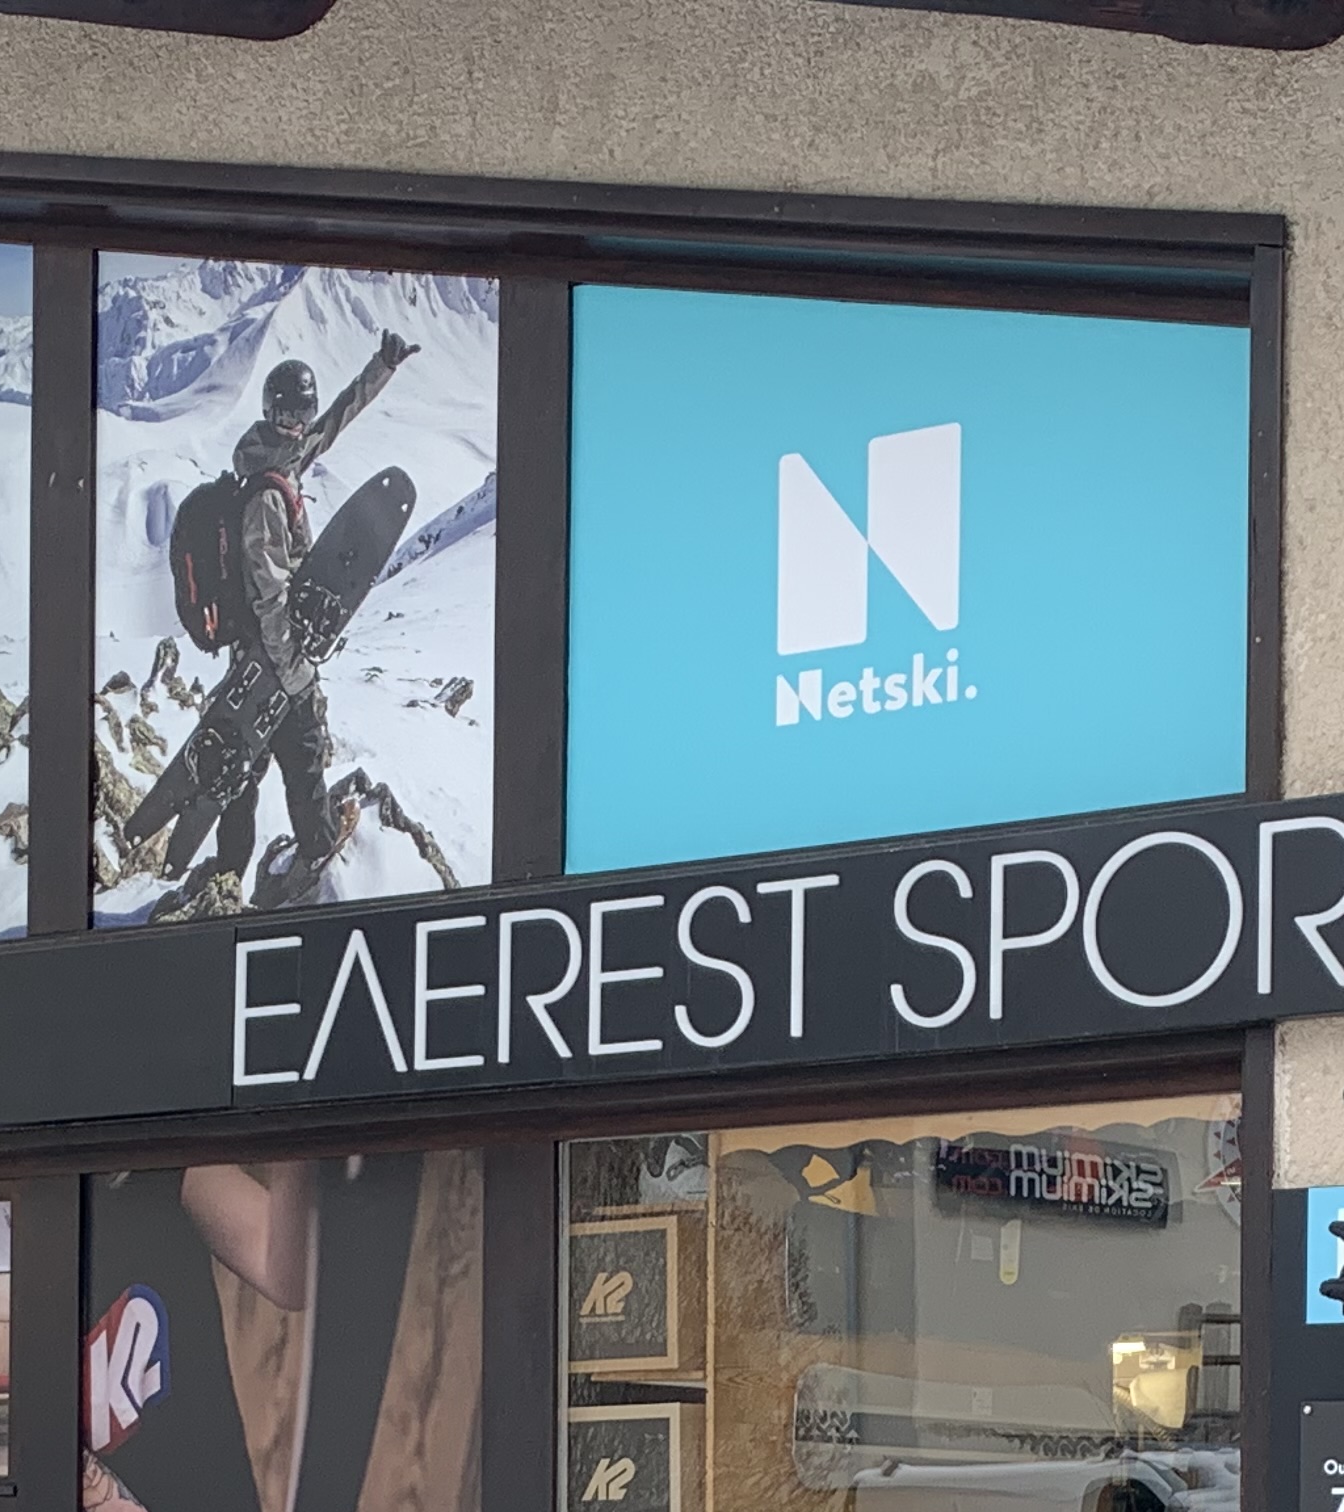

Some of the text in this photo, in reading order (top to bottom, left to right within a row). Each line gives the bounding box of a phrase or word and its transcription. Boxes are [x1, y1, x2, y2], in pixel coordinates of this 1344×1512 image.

[579, 1271, 633, 1315] K2
[89, 1296, 161, 1452] K2
[581, 1457, 635, 1501] K2
